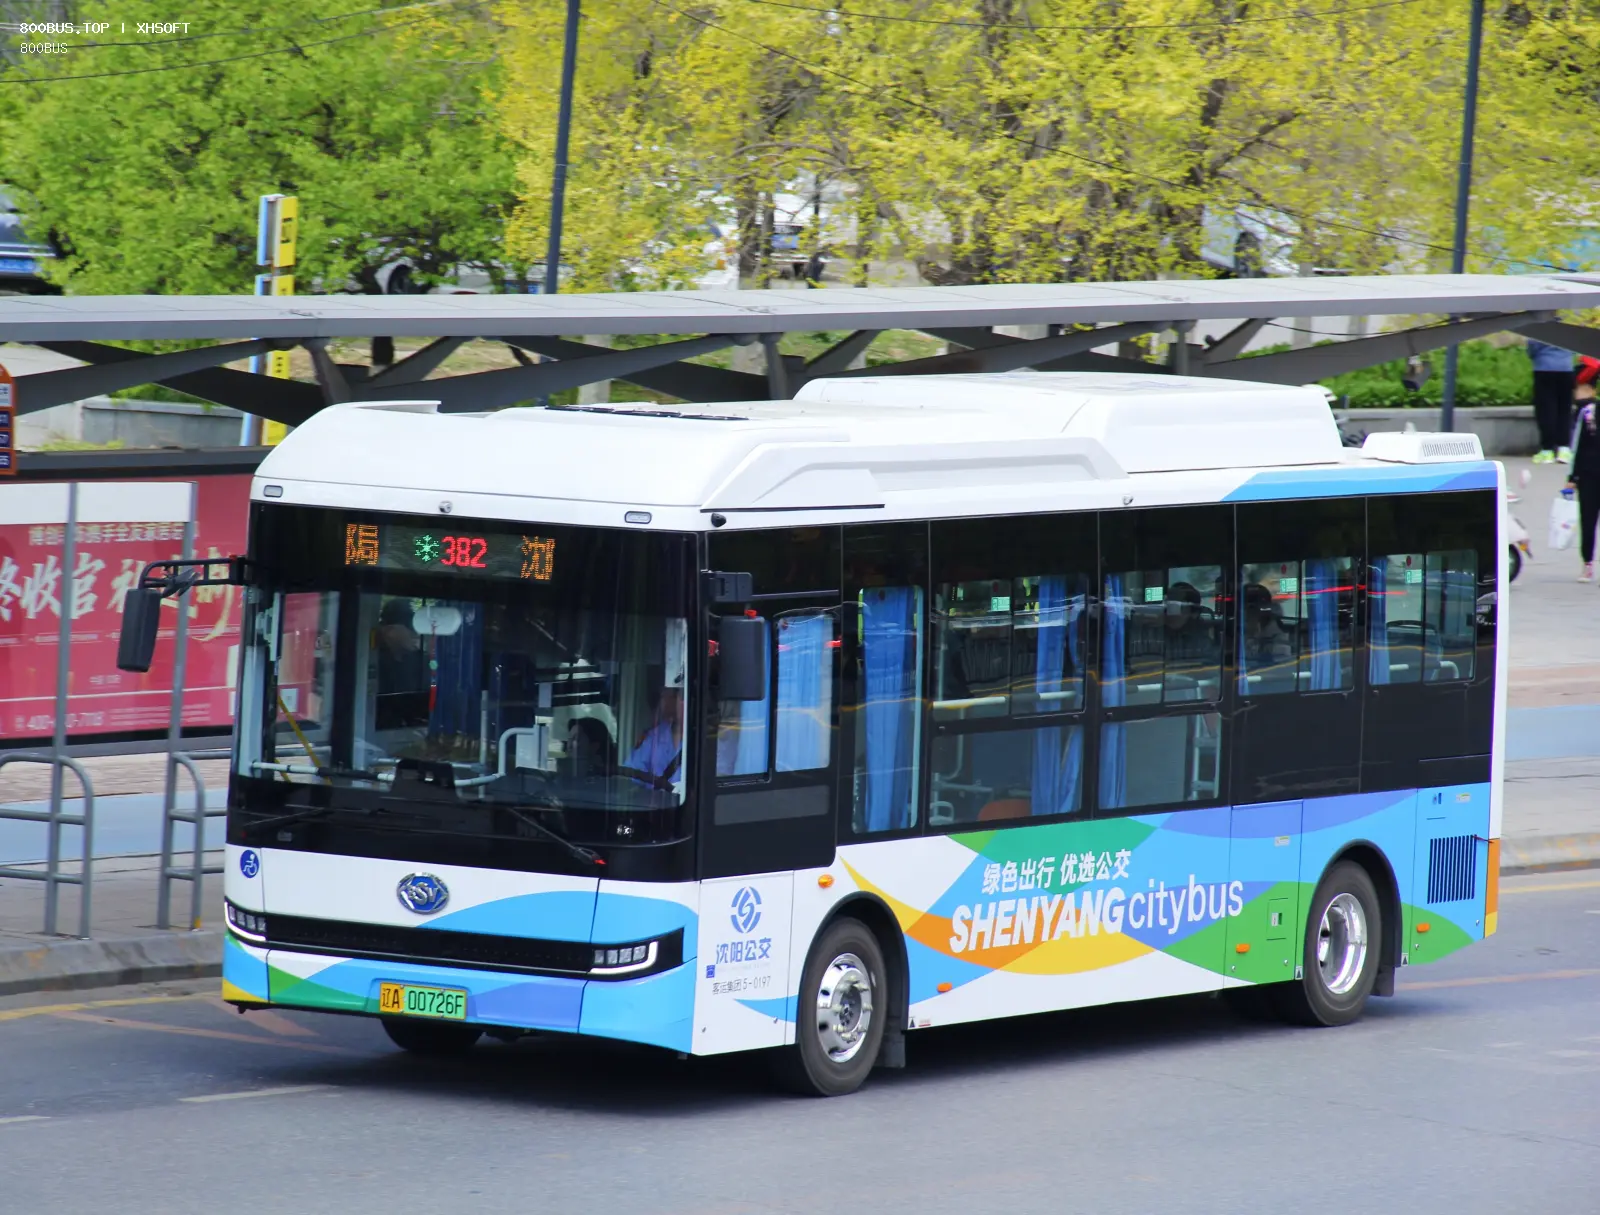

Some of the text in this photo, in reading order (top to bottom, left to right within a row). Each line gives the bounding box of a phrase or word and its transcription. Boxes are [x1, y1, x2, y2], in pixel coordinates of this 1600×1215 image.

[440, 536, 487, 568] 382
[982, 849, 1132, 895] 绿色出行 优选公交
[949, 873, 1244, 954] SHENYANG citybus
[716, 937, 772, 965] 沈阳公交
